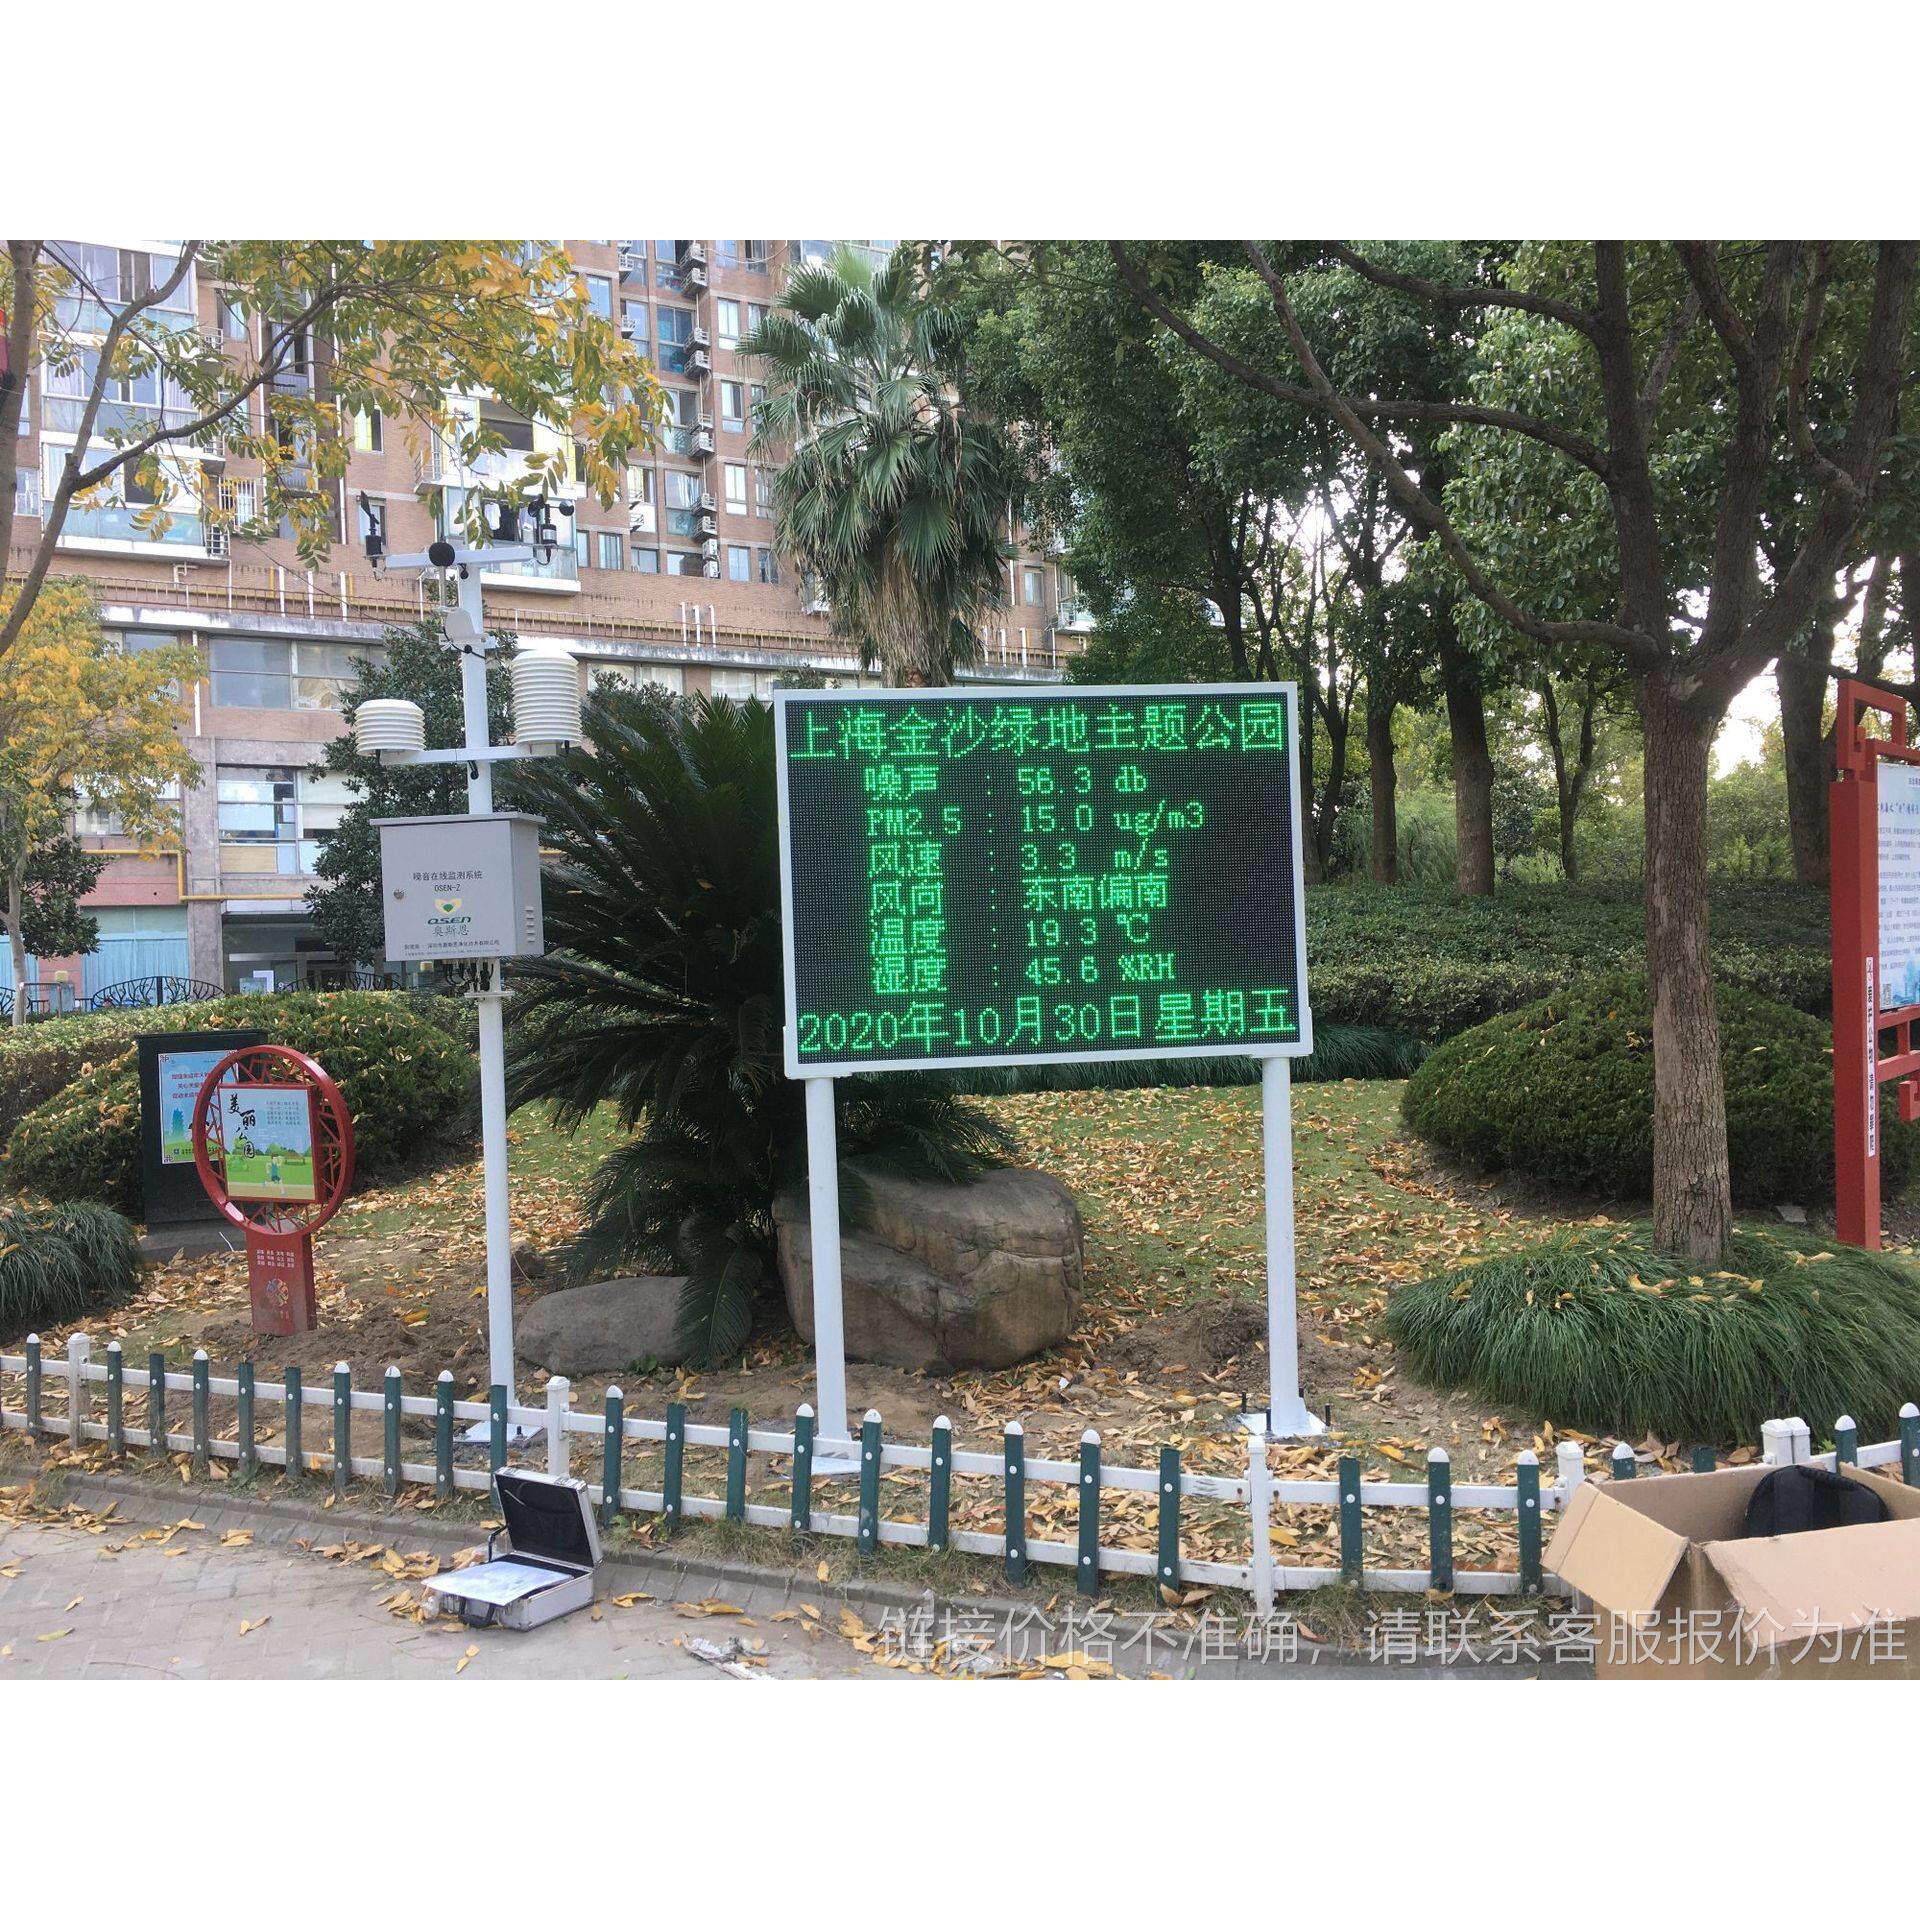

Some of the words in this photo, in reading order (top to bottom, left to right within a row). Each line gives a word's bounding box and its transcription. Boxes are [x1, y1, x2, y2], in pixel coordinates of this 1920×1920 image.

[790, 702, 1284, 759] 上海金沙绿地主题公园
[863, 764, 939, 800] 噪声
[1017, 764, 1093, 795] 56.3
[1114, 764, 1148, 793] db
[865, 805, 962, 836] PM2.5
[1022, 803, 1094, 834] 15.0
[1113, 800, 1205, 836] ug/m3
[868, 842, 943, 879] 风速
[1021, 842, 1077, 871] 3.3
[1114, 837, 1169, 871] m/s
[869, 881, 944, 916] 风向
[1023, 873, 1169, 910] 东南偏南
[870, 919, 946, 955] 温度
[1026, 916, 1099, 947] 19.3
[871, 957, 947, 995] 湿度
[1025, 955, 1100, 985] 45.6
[1118, 952, 1176, 983] %RH
[1156, 988, 1296, 1041] 星期五
[228, 1093, 256, 1159] 美丽公园
